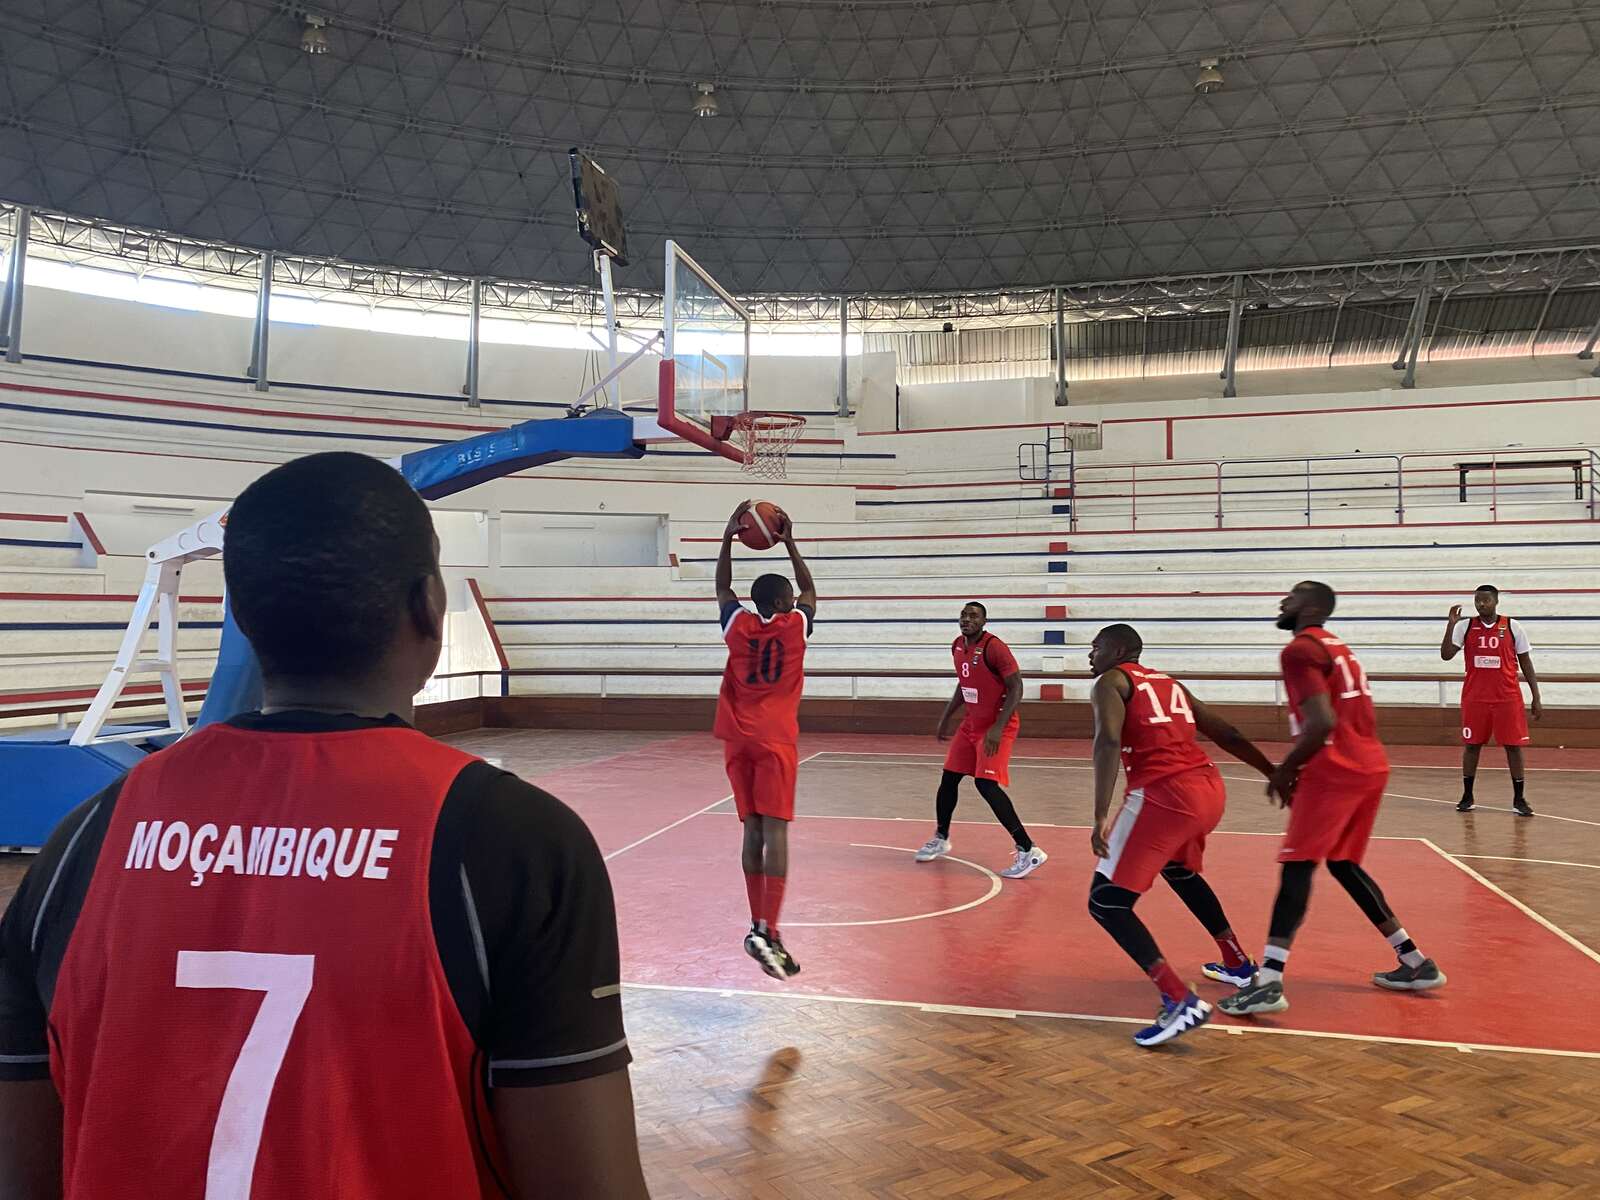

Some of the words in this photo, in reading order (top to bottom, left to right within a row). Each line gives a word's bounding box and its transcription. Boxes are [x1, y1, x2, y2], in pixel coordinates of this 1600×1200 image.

[746, 638, 785, 685] 10
[1478, 636, 1500, 649] 10
[961, 662, 970, 678] 8
[1136, 682, 1195, 724] 14
[125, 820, 399, 887] MOÇAMBIQUE
[175, 950, 315, 1200] 7
